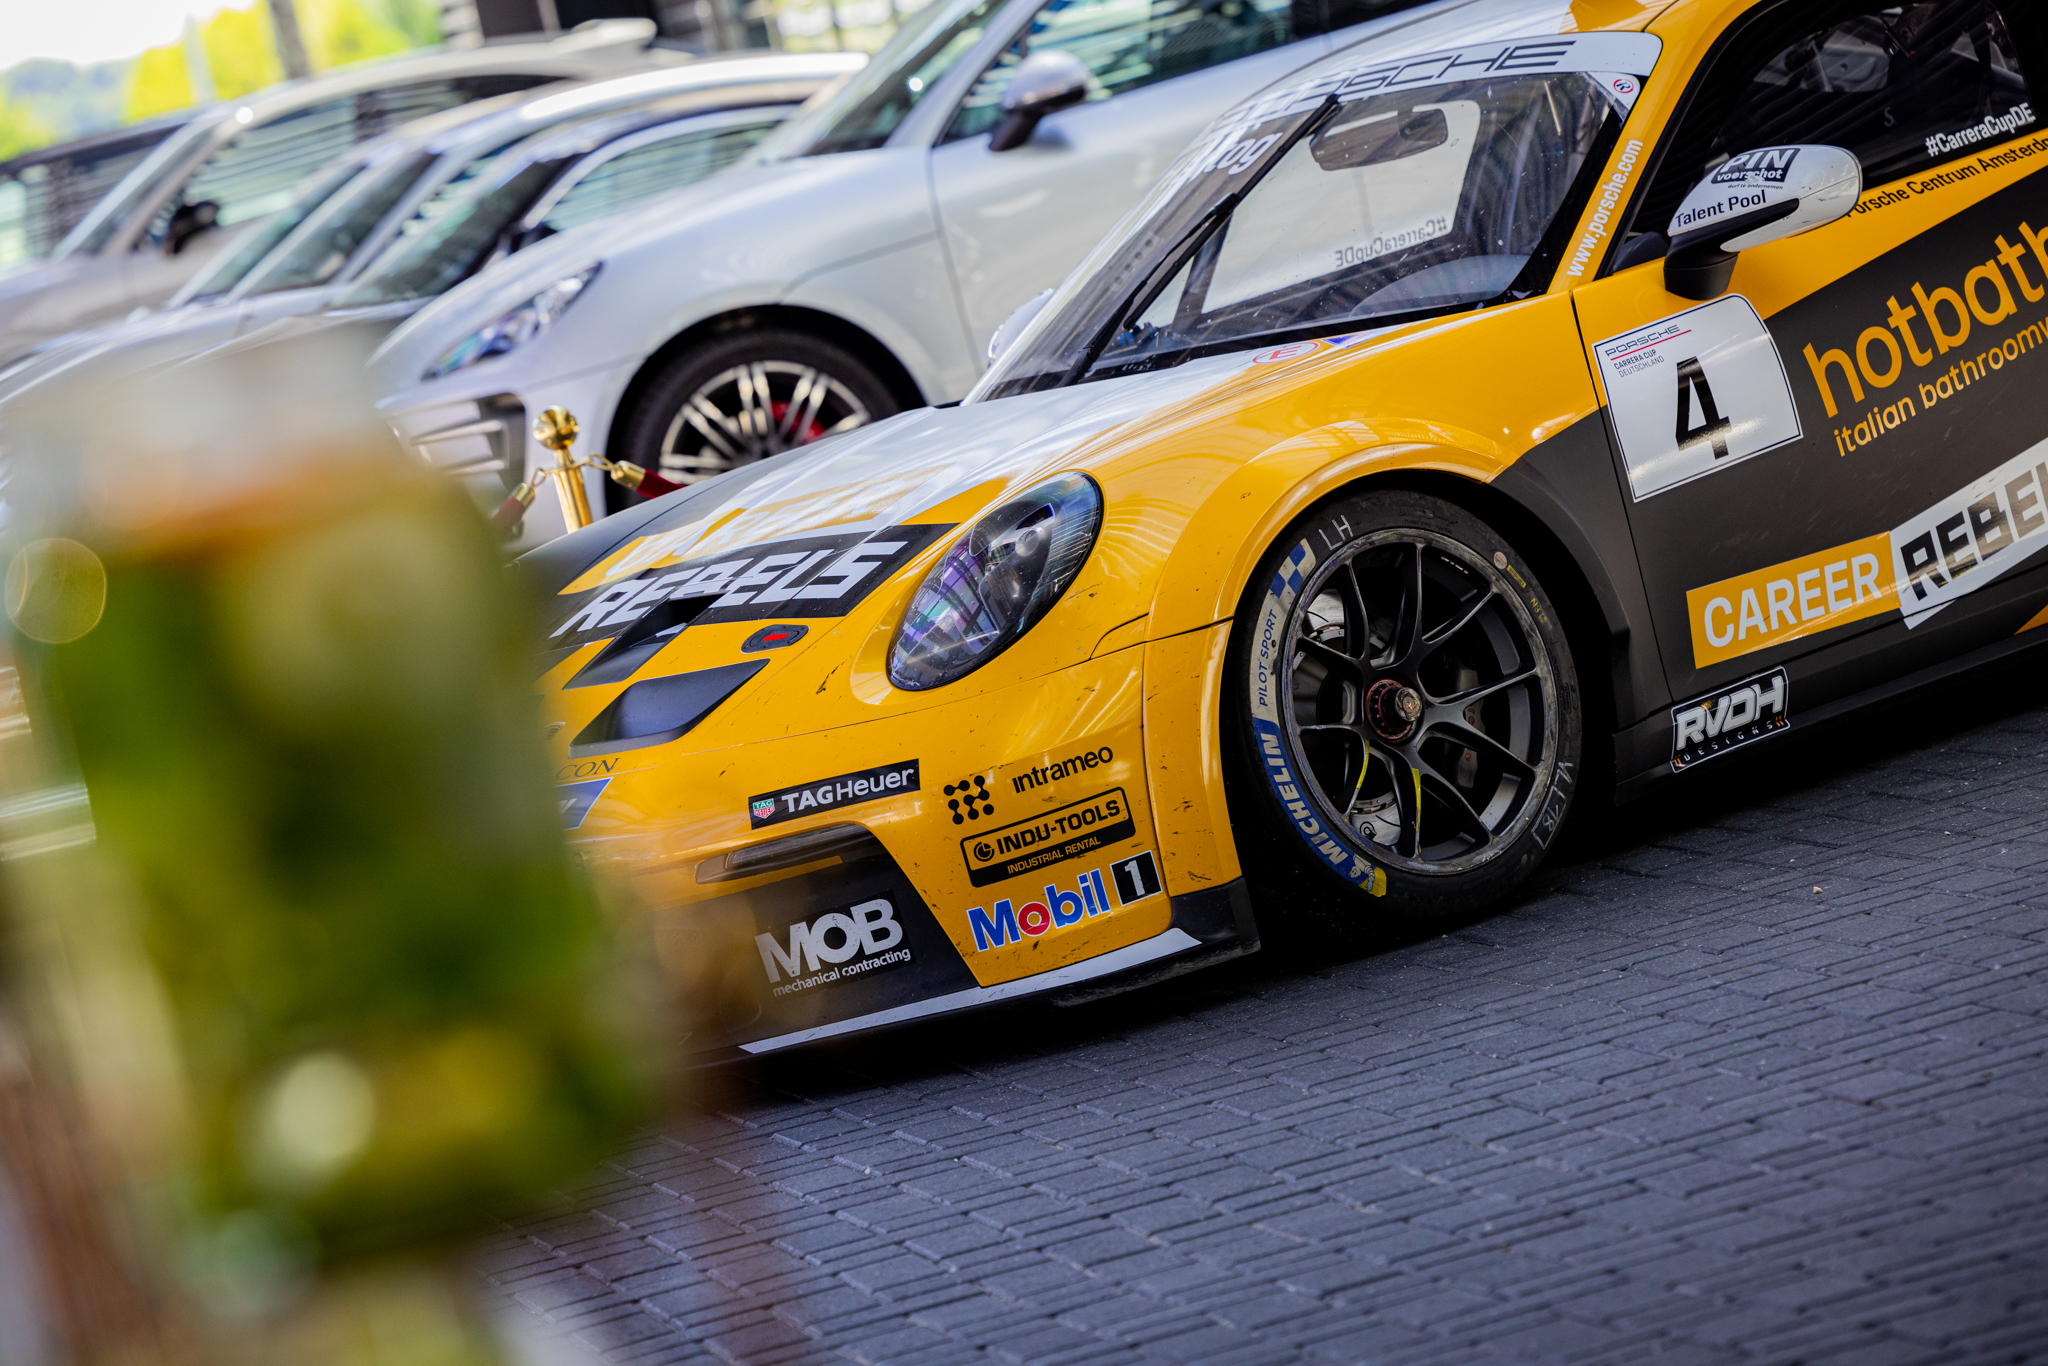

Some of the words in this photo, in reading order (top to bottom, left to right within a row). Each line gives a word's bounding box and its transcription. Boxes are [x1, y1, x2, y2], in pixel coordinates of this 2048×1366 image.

[1925, 102, 2036, 157] #CarreraCupDE
[1717, 168, 1783, 181] voorschot
[1720, 149, 1795, 173] PIN
[1567, 139, 1644, 277] www.porsche.com
[1675, 202, 1724, 227] Talent
[1728, 190, 1767, 211] Pool
[1847, 189, 1910, 218] orsche
[1906, 163, 1980, 195] Centrum
[1605, 324, 1681, 357] PORSCHE
[1803, 221, 2048, 419] hotbath
[1613, 354, 1644, 370] CARRERA
[1643, 348, 1657, 361] CUP
[1618, 355, 1665, 378] DEUTSCHLAND
[1675, 356, 1733, 460] 4
[1834, 397, 1916, 457] italian
[1318, 514, 1354, 550] LH
[548, 541, 908, 639] REBELS
[1704, 553, 1883, 648] CAREER
[1260, 608, 1278, 659] SPORT
[1258, 661, 1269, 707] PILOT
[1675, 675, 1785, 751] RVDH
[754, 800, 773, 809] TAG
[1260, 733, 1349, 865] MICHELIN
[996, 799, 1121, 855] INDU-TOOLS
[1007, 850, 1064, 875] INDUSTRIAL
[1064, 836, 1102, 856] RENTAL
[966, 868, 1112, 953] Mobil
[1124, 859, 1146, 897] 1
[754, 898, 903, 984] MOB
[772, 967, 841, 998] mechanical
[842, 948, 912, 977] contracting
